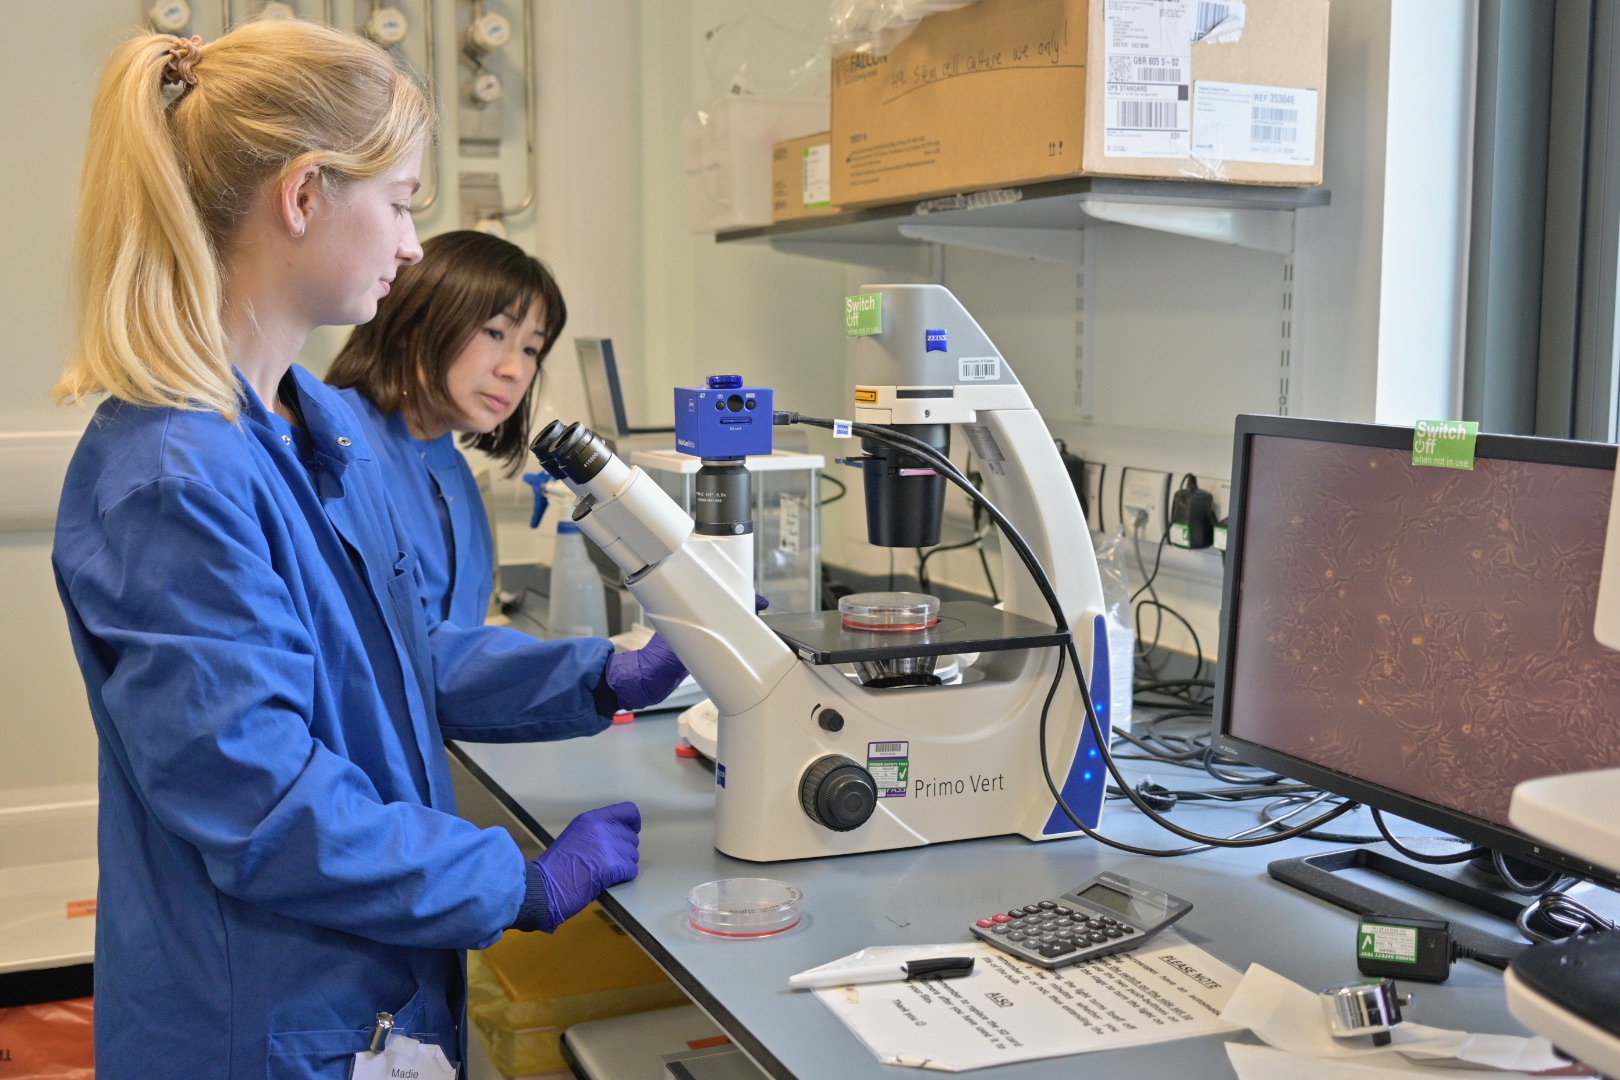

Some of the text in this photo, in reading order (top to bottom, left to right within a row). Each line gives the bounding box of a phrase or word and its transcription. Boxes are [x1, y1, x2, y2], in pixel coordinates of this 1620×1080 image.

[942, 54, 958, 77] cell
[1133, 56, 1147, 65] GBR
[1148, 57, 1160, 66] 805
[1254, 94, 1268, 103] REF
[1269, 94, 1295, 105] 353046
[846, 296, 875, 312] Switch
[1417, 421, 1466, 440] Switch
[1414, 455, 1432, 464] when
[915, 774, 1004, 798] Primo Vert
[1159, 975, 1177, 986] have
[1162, 955, 1222, 988] PLEASE NOTE
[908, 984, 923, 994] your
[1114, 979, 1129, 988] two
[1119, 972, 1142, 985] switch
[1147, 990, 1162, 998] the
[1158, 998, 1175, 1007] side
[987, 992, 1014, 1007] ALSO
[995, 955, 1024, 975] remember
[1048, 995, 1064, 1005] thus
[1061, 1005, 1093, 1027] extending
[1090, 1026, 1104, 1035] the
[1034, 971, 1047, 980] few
[1050, 983, 1074, 999] minutes
[1076, 1002, 1103, 1019] whether
[1104, 1023, 1120, 1032] you
[1075, 988, 1092, 999] light
[1088, 998, 1108, 1010] turns
[1106, 1010, 1126, 1022] itself
[1090, 975, 1108, 986] stage
[1113, 990, 1129, 1000] turn
[1126, 1000, 1140, 1008] the
[1138, 1008, 1156, 1018] light
[892, 999, 910, 1013] Thank
[903, 1012, 918, 1021] you
[938, 996, 954, 1006] after
[950, 1006, 964, 1015] you
[962, 1015, 978, 1026] have
[975, 1026, 994, 1038] used
[968, 1005, 989, 1020] replace
[986, 1020, 999, 1028] the
[1005, 1036, 1024, 1047] card
[391, 1068, 419, 1079] Madie
